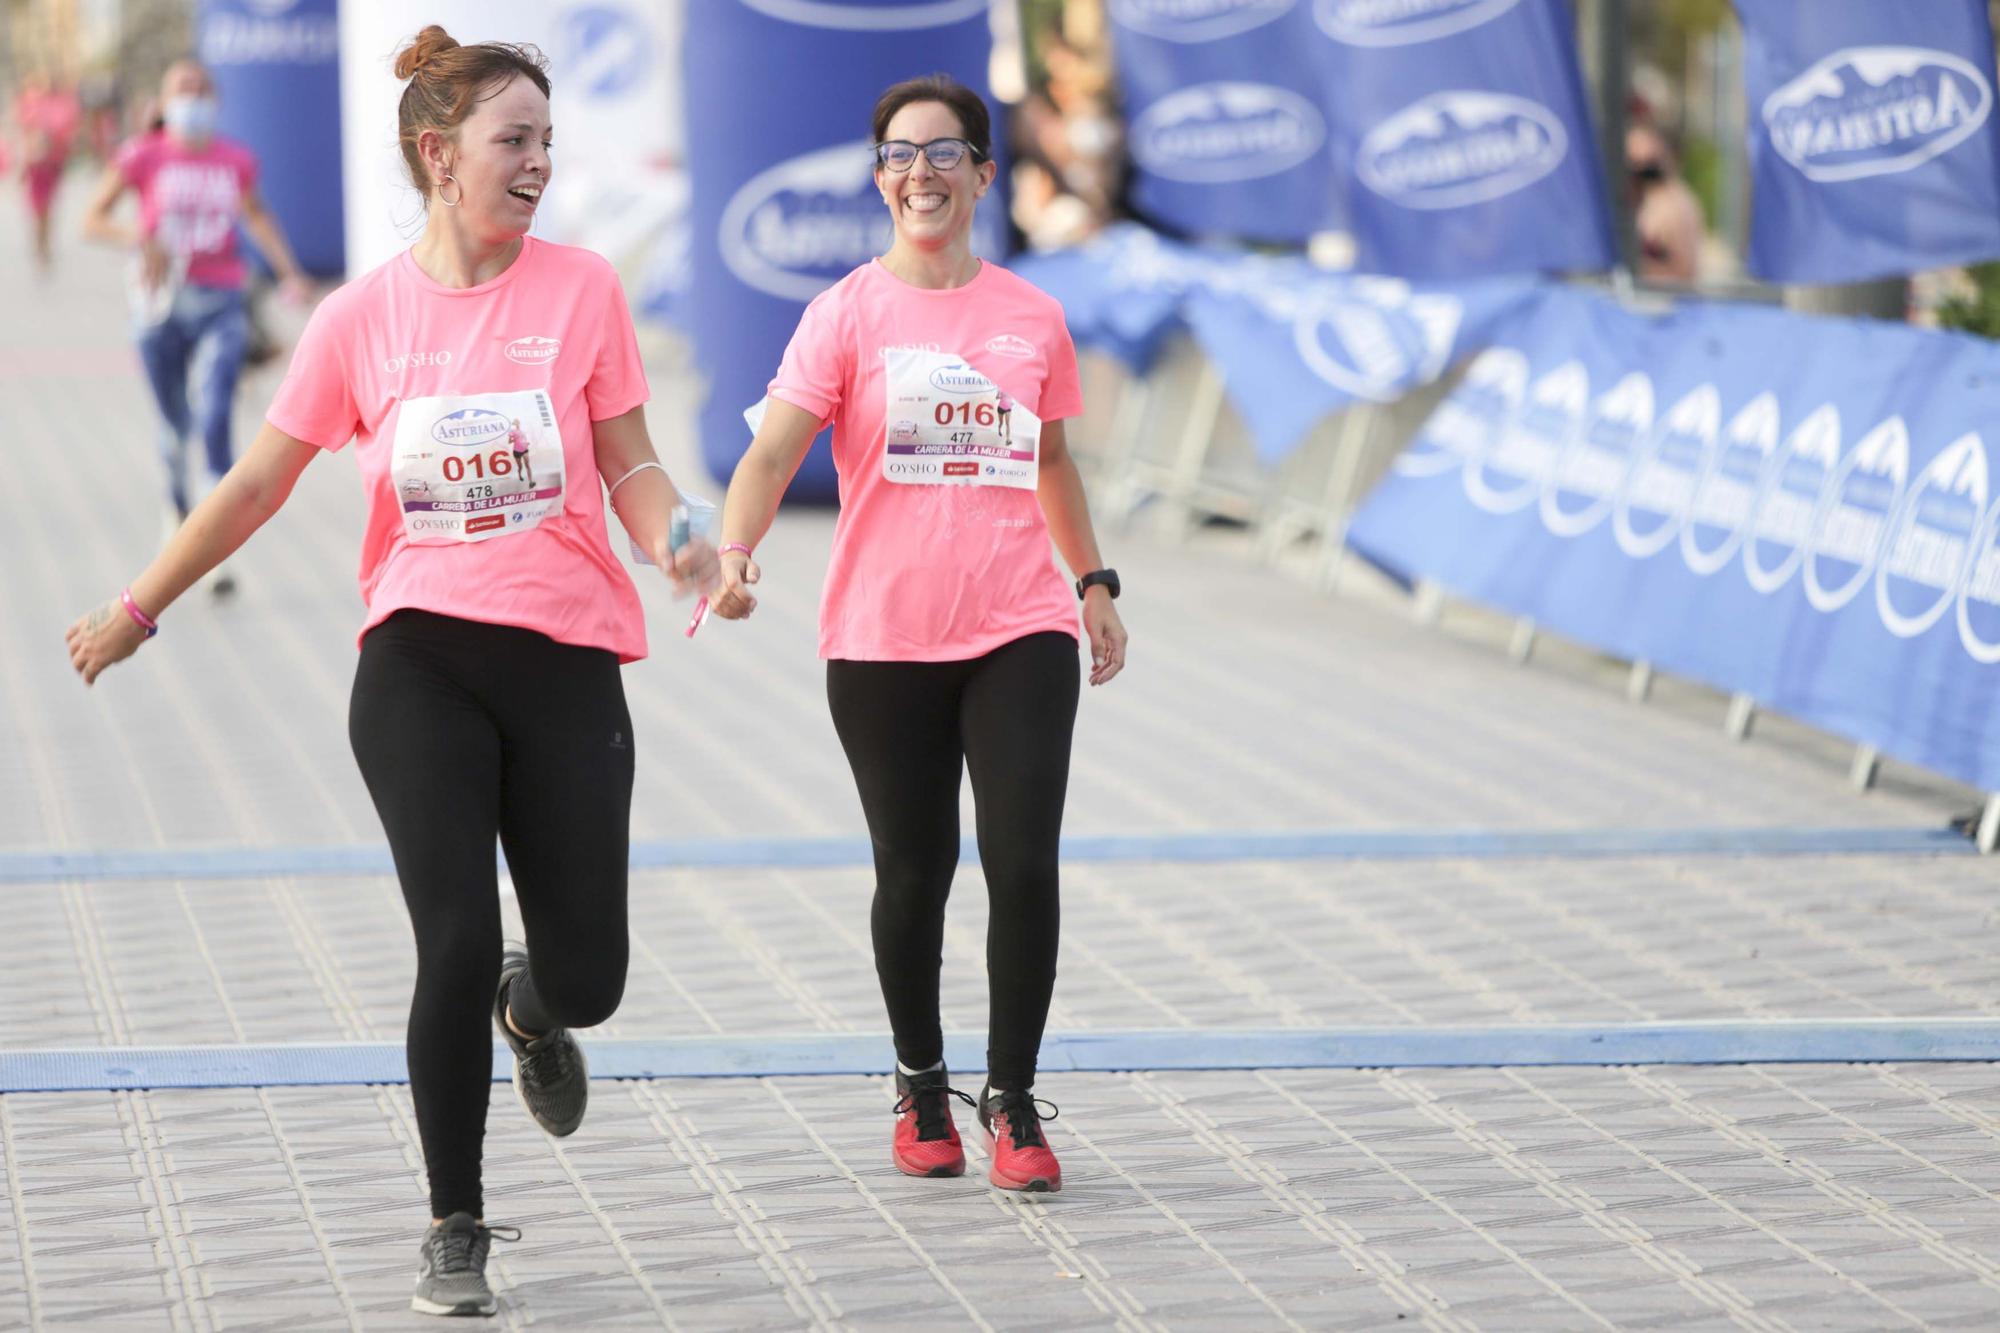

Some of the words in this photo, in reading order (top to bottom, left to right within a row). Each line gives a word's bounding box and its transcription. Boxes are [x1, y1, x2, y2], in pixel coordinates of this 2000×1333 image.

[384, 350, 452, 373] OYSHO
[936, 372, 992, 385] ASTURIAN
[935, 402, 994, 426] 016
[438, 421, 505, 439] ASTURIANA
[951, 432, 973, 443] 477
[915, 445, 953, 455] CARRERA
[954, 445, 966, 454] DE
[967, 445, 979, 454] LA
[980, 447, 1011, 458] MUJER
[443, 450, 512, 481] 016
[889, 463, 937, 474] OYSHO
[466, 485, 493, 499] 478
[431, 502, 472, 512] CARRERA
[474, 500, 487, 509] DE
[489, 498, 502, 507] LA
[503, 492, 537, 505] MUJER
[413, 518, 459, 530] OYSHO
